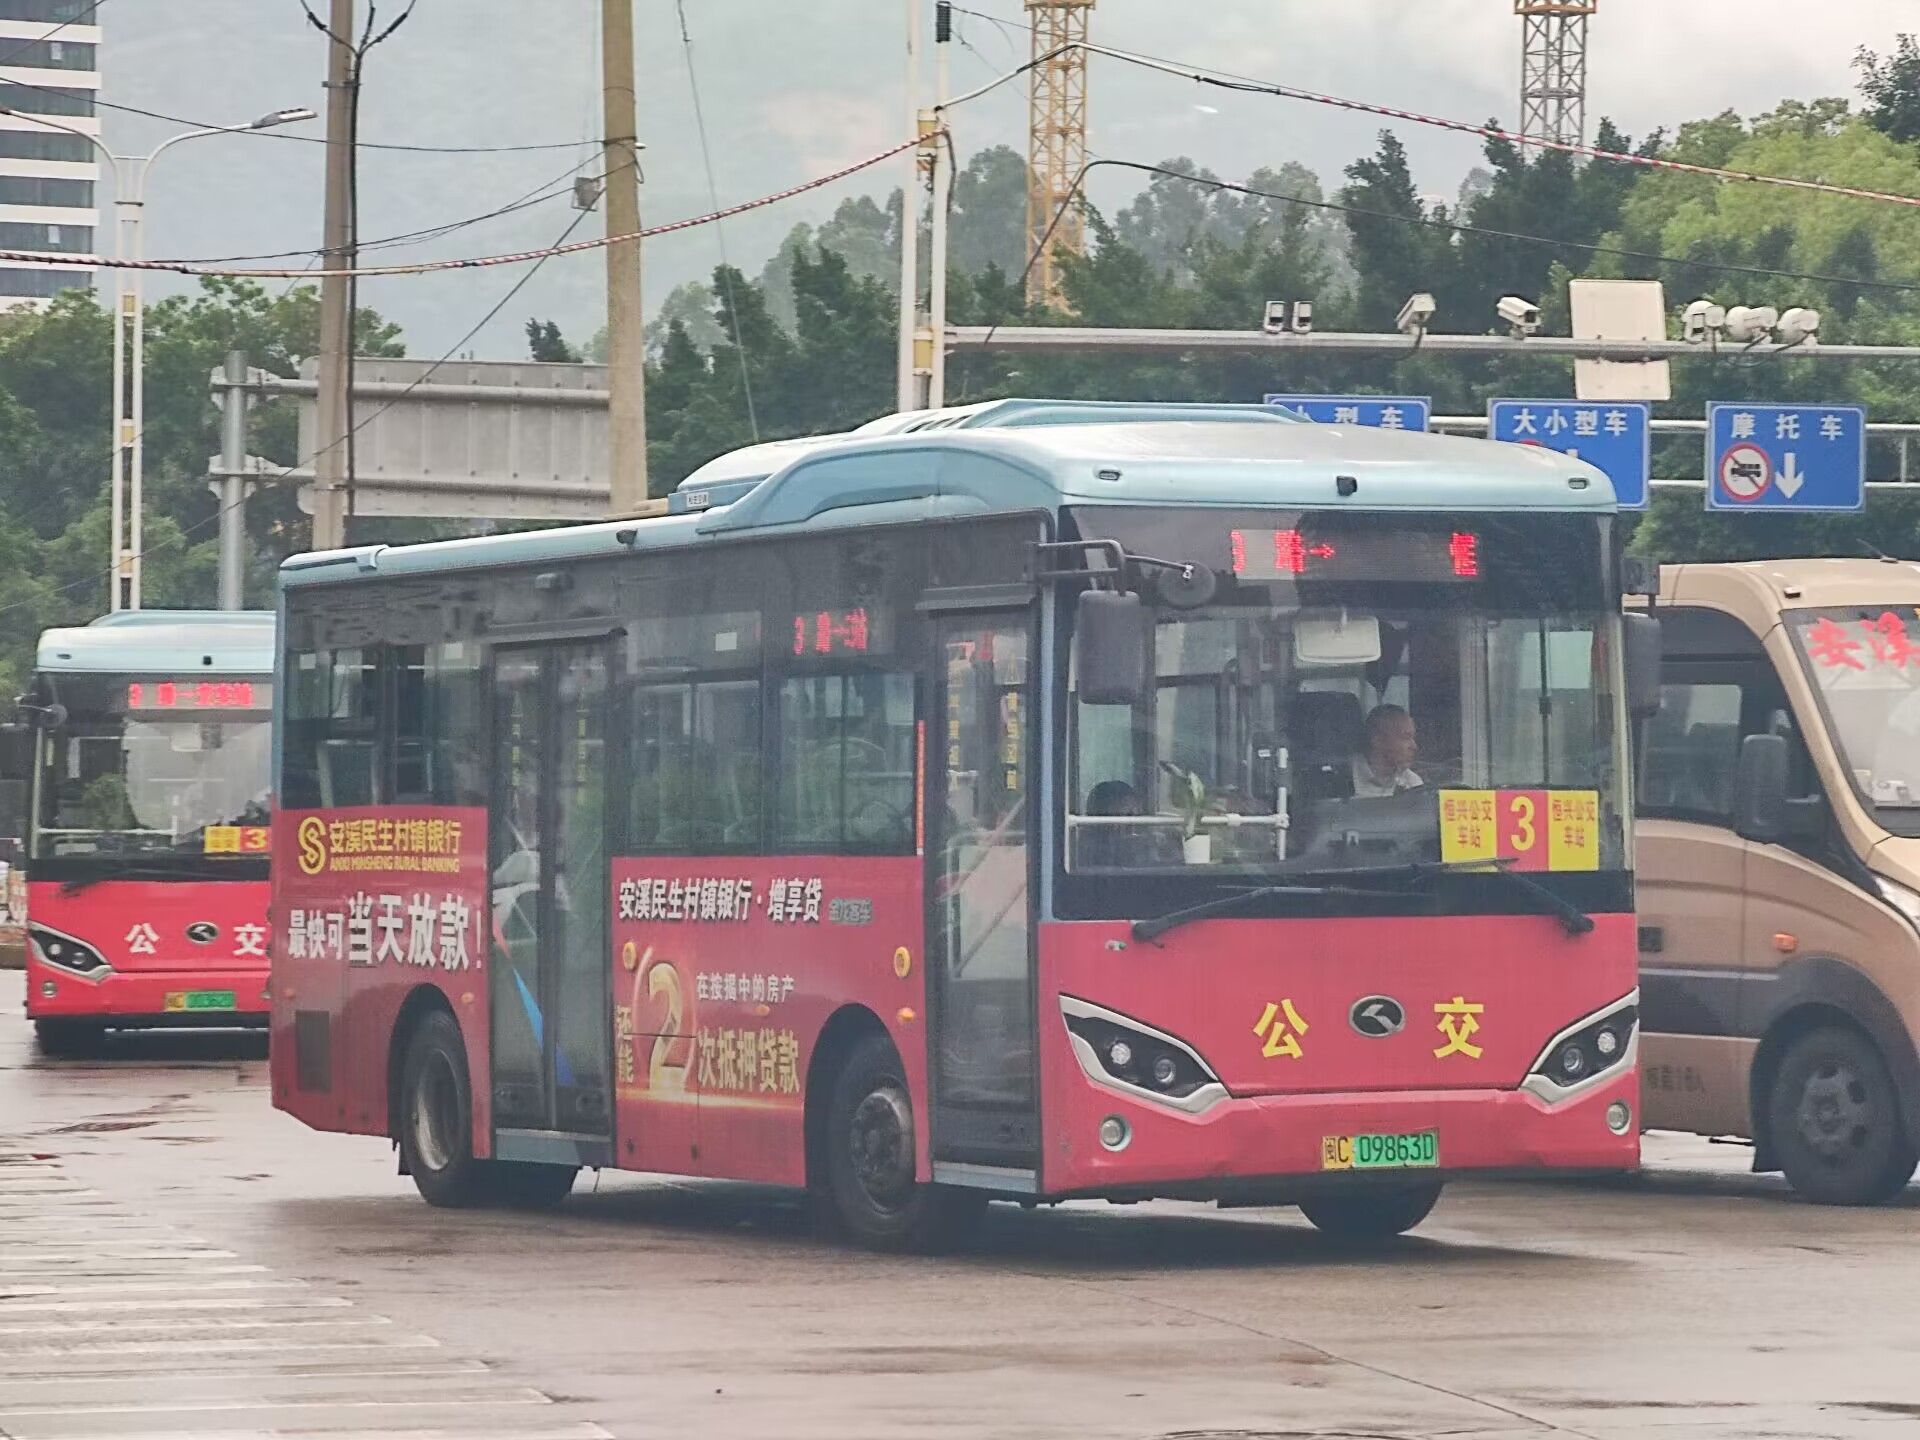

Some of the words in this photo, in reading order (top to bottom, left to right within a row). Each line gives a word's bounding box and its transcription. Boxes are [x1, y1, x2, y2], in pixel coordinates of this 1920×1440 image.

[1513, 408, 1628, 436] 大小型车
[1731, 413, 1844, 441] 摩托车
[329, 818, 461, 854] 安溪民生村镇银行
[1510, 796, 1536, 851] 3
[245, 828, 268, 849] 3
[697, 972, 795, 1003] 在按揭中的房产
